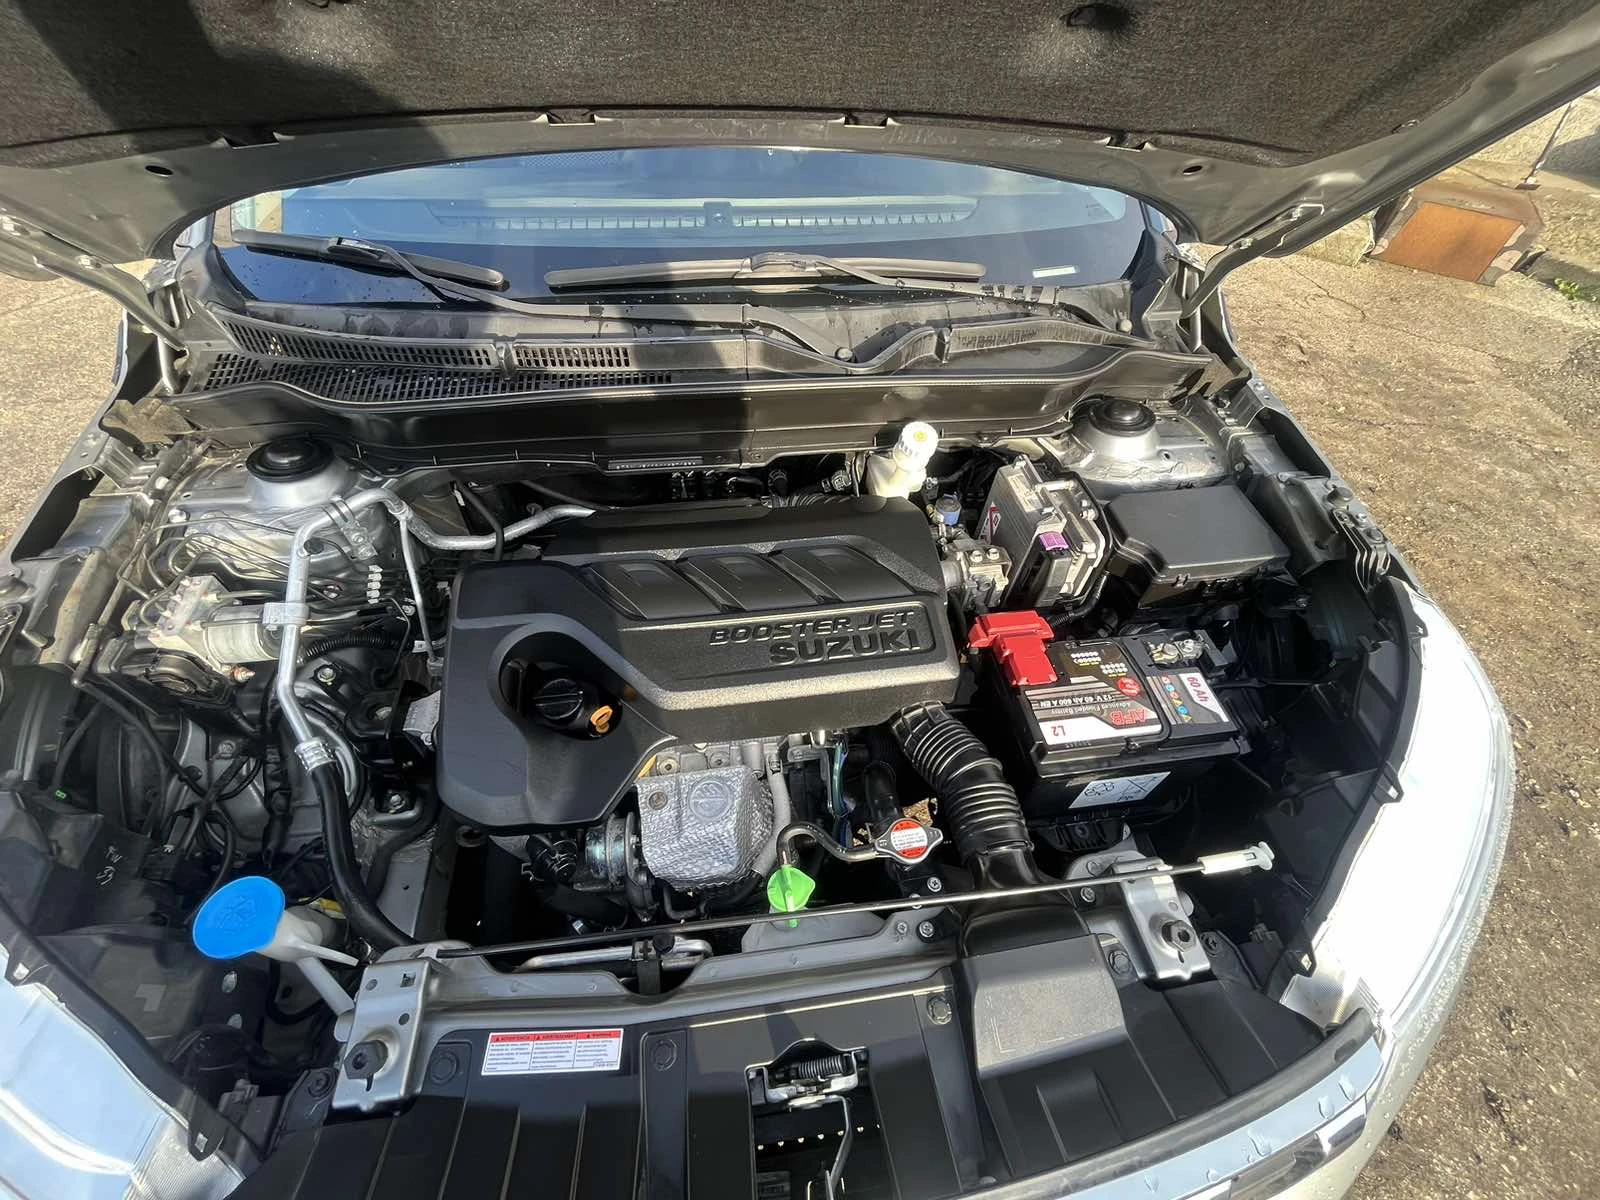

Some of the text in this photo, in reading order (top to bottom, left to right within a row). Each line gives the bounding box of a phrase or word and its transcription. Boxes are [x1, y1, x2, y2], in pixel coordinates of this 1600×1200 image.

[769, 628, 921, 666] SUZUKI
[1186, 676, 1210, 703] 60 Ah
[1111, 709, 1147, 726] AFB
[1051, 725, 1067, 737] L2
